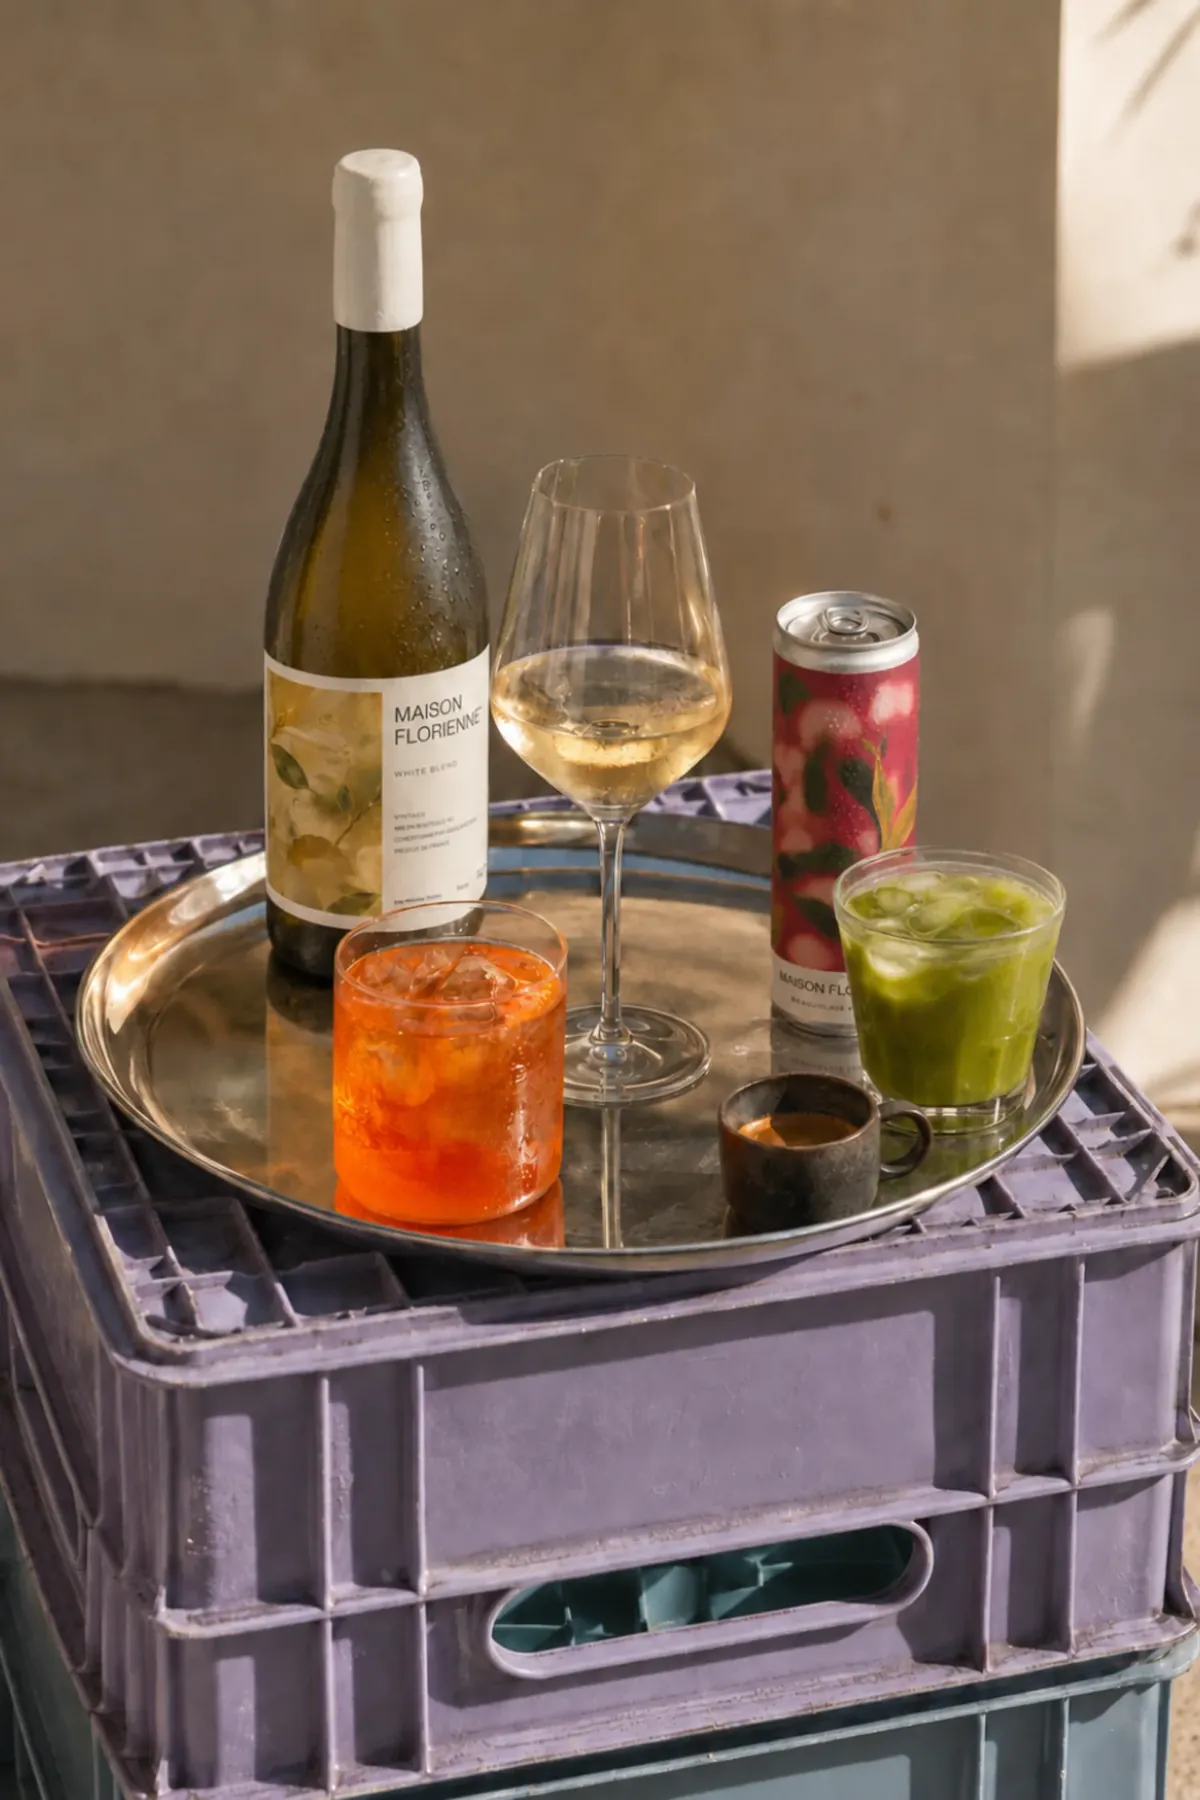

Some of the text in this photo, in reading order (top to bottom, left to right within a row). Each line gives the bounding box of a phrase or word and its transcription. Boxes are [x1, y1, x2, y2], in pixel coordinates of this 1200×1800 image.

[395, 694, 462, 723] MAISON
[394, 706, 482, 746] FLORIENNE
[394, 760, 458, 778] WHITE BLEND
[779, 969, 825, 994] MAISON
